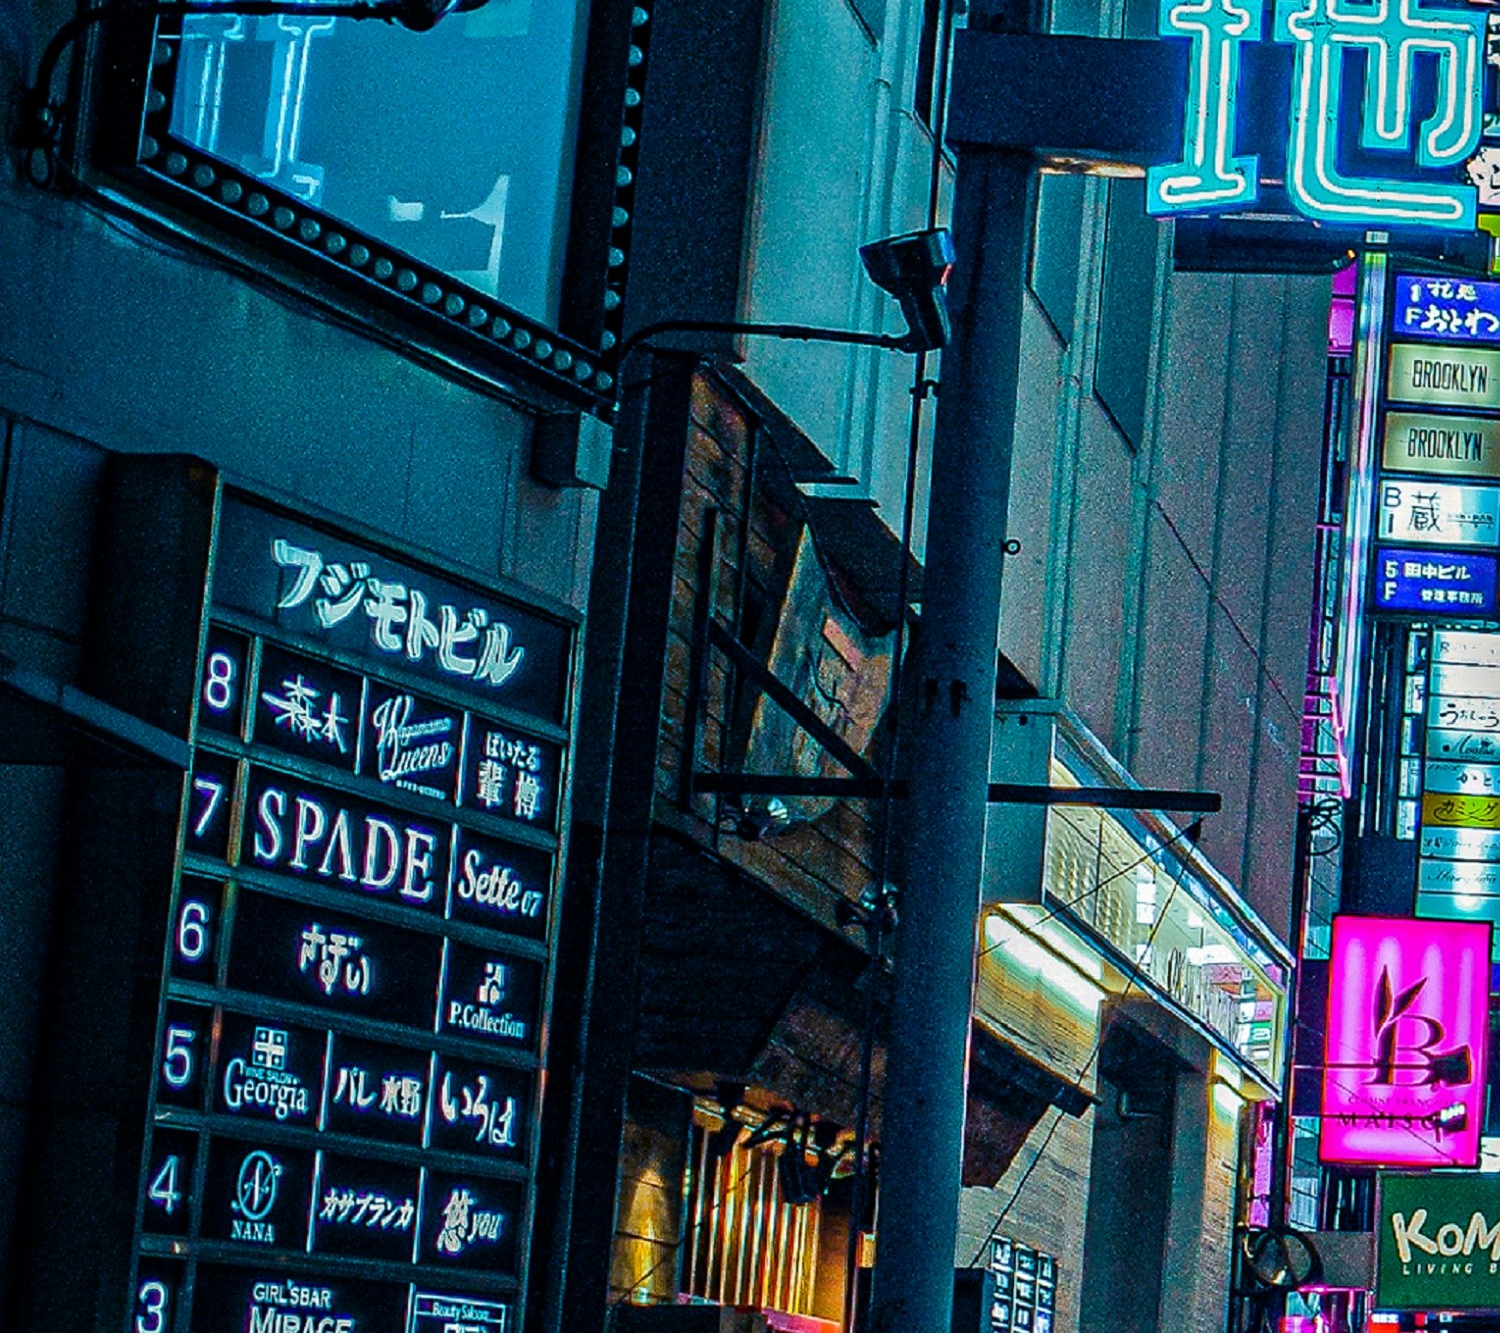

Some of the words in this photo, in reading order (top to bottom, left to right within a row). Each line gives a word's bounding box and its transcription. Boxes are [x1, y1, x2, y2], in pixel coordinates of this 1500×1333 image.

[1413, 360, 1488, 393] BROOKLYN
[1408, 428, 1483, 461] BROOKLYN
[1404, 563, 1471, 581] 田中ビル
[271, 539, 524, 686] フジモトビル
[204, 652, 233, 709] 8
[262, 675, 348, 752] 森本
[193, 777, 223, 835] 7
[254, 789, 437, 901] SPADE
[458, 850, 521, 914] Sette
[178, 901, 206, 958] 6
[450, 1005, 523, 1038] P.Collection
[163, 1028, 194, 1085] 5
[224, 1058, 307, 1119] Georgia
[442, 1072, 515, 1148] いろは
[148, 1154, 182, 1213] 4
[320, 1188, 414, 1229] カサブランカ
[231, 1221, 274, 1243] NANA
[301, 1285, 331, 1309] BAR
[1402, 1263, 1472, 1276] LIVING
